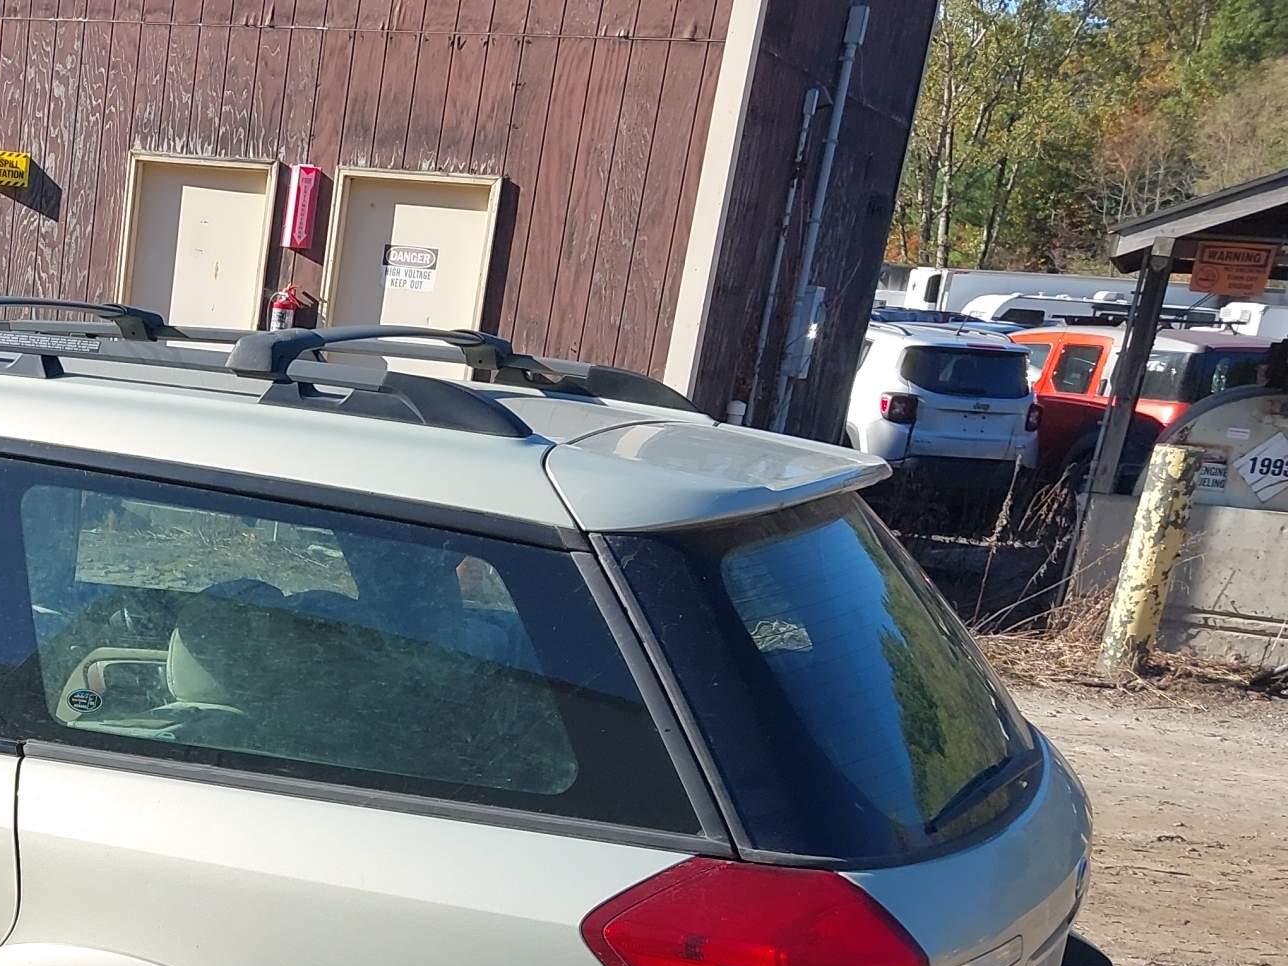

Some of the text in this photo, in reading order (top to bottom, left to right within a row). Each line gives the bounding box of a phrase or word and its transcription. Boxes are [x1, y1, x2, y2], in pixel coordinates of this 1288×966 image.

[0, 158, 20, 170] SPILL
[390, 250, 431, 265] DANGER
[1208, 250, 1261, 263] WARNING
[404, 268, 432, 280] VOLTAGE
[391, 278, 423, 290] KEEP OUT
